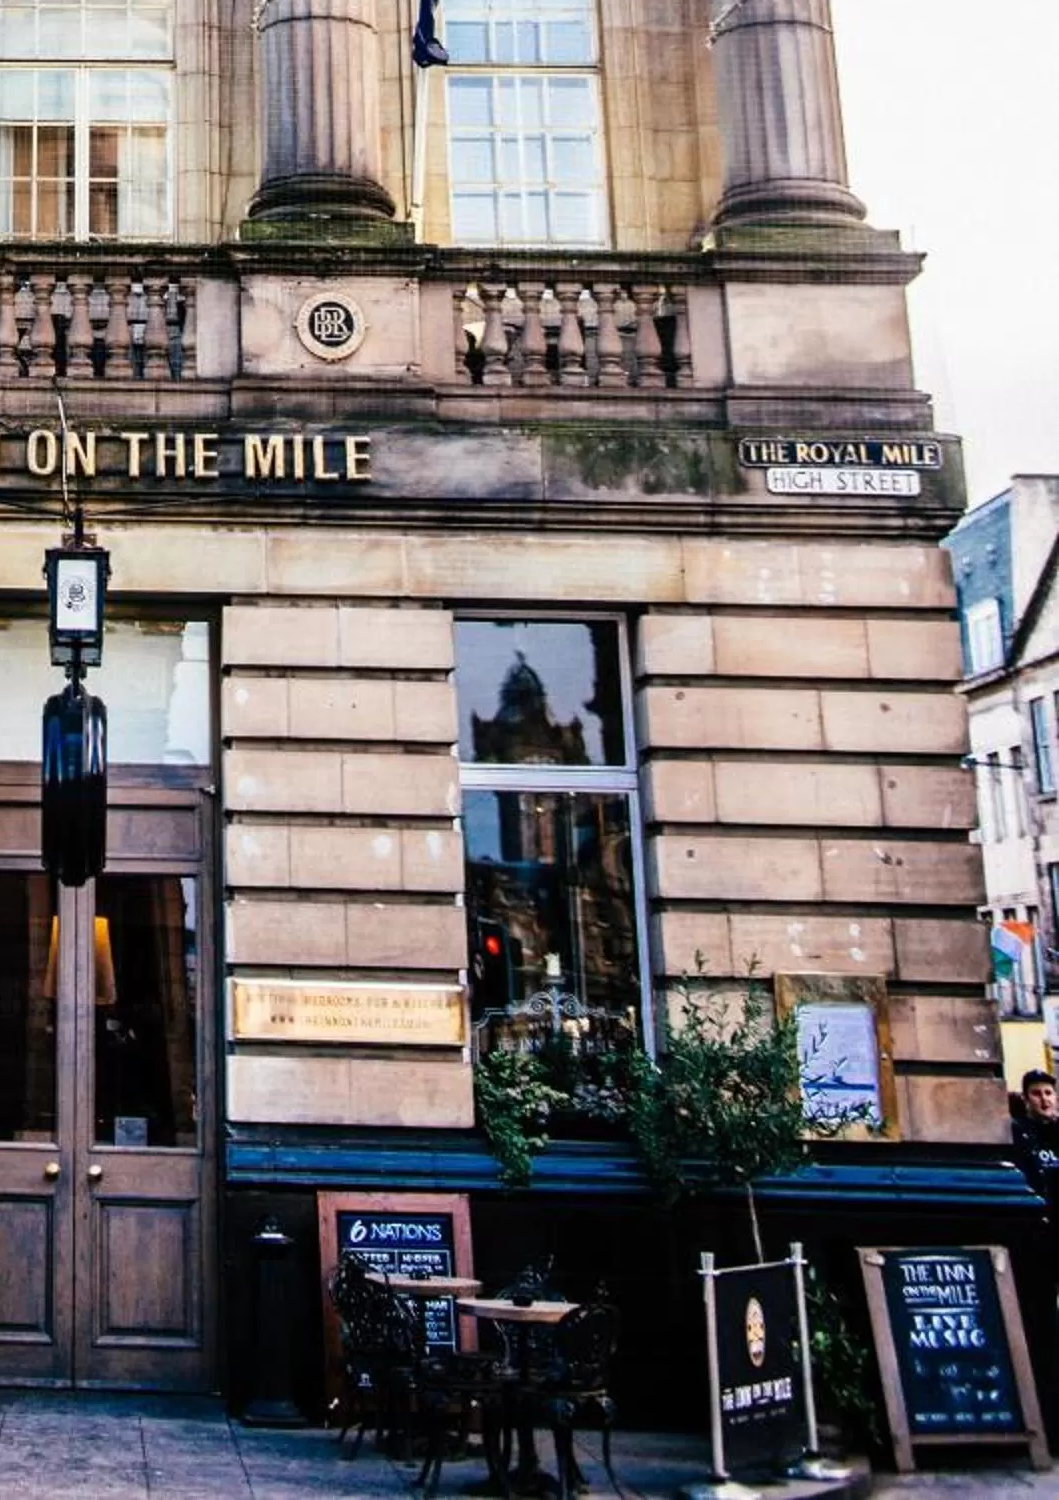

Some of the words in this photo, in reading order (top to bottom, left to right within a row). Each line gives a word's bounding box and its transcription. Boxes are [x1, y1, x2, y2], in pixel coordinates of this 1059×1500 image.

[26, 429, 97, 477] ON
[121, 431, 220, 478] THE
[244, 434, 372, 481] MILE
[745, 441, 790, 463] THE
[796, 443, 873, 463] ROYAL
[881, 444, 936, 465] MILE
[772, 471, 824, 491] HIGH
[835, 471, 915, 493] STREET
[349, 1219, 367, 1243] 6
[370, 1222, 443, 1242] NATIONS
[900, 1263, 932, 1282] THE
[936, 1263, 976, 1282] INN
[913, 1315, 978, 1331] LIVE
